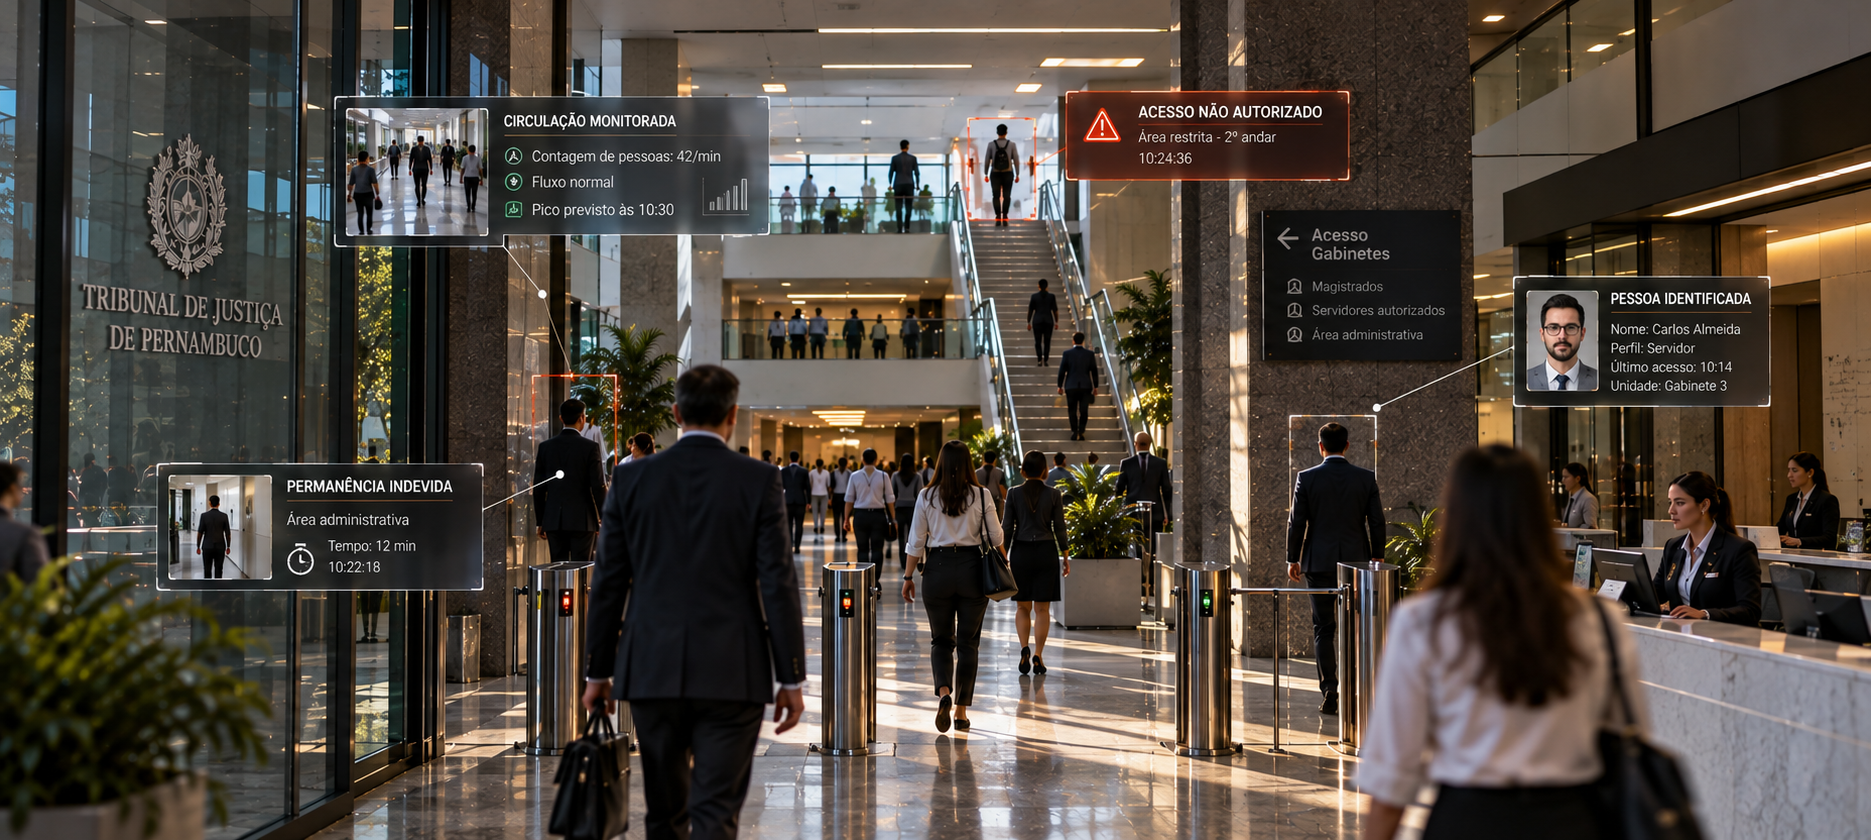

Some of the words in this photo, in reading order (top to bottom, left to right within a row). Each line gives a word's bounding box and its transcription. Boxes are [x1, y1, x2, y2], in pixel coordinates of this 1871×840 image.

[1312, 228, 1368, 241] Acesso
[1312, 246, 1390, 260] Gabinetes
[1313, 281, 1383, 294] Magistrados
[83, 284, 179, 317] TRIBUNAL
[184, 295, 207, 318] DE
[212, 298, 283, 330] JUSTIÇA
[1313, 305, 1374, 315] Servidores
[1378, 305, 1445, 315] autorizados
[1312, 327, 1338, 340] Área
[1343, 329, 1423, 340] administrativa
[109, 325, 135, 350] DE
[141, 327, 262, 358] PERNAMBUCO
